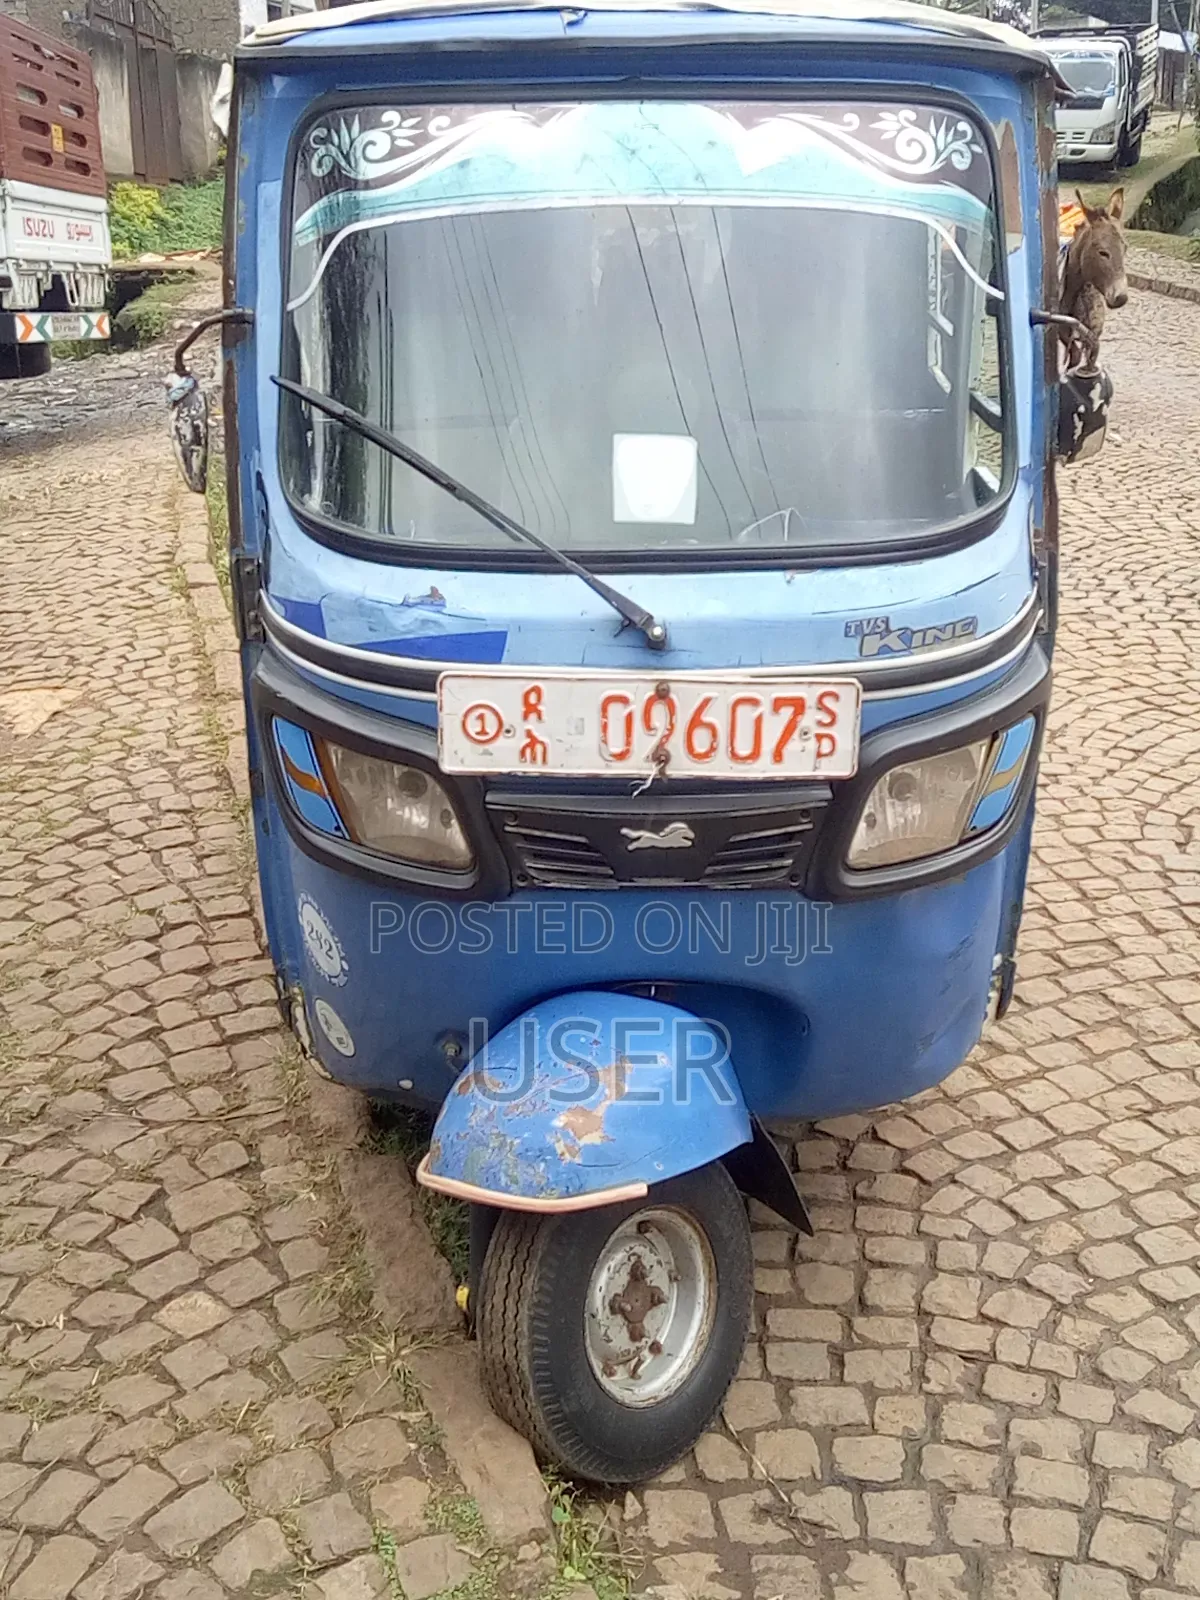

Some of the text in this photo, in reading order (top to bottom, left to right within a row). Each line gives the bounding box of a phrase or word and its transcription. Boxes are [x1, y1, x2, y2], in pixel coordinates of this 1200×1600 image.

[22, 216, 55, 239] ISUZU
[845, 616, 978, 657] TVS KING
[599, 692, 807, 765] 09607
